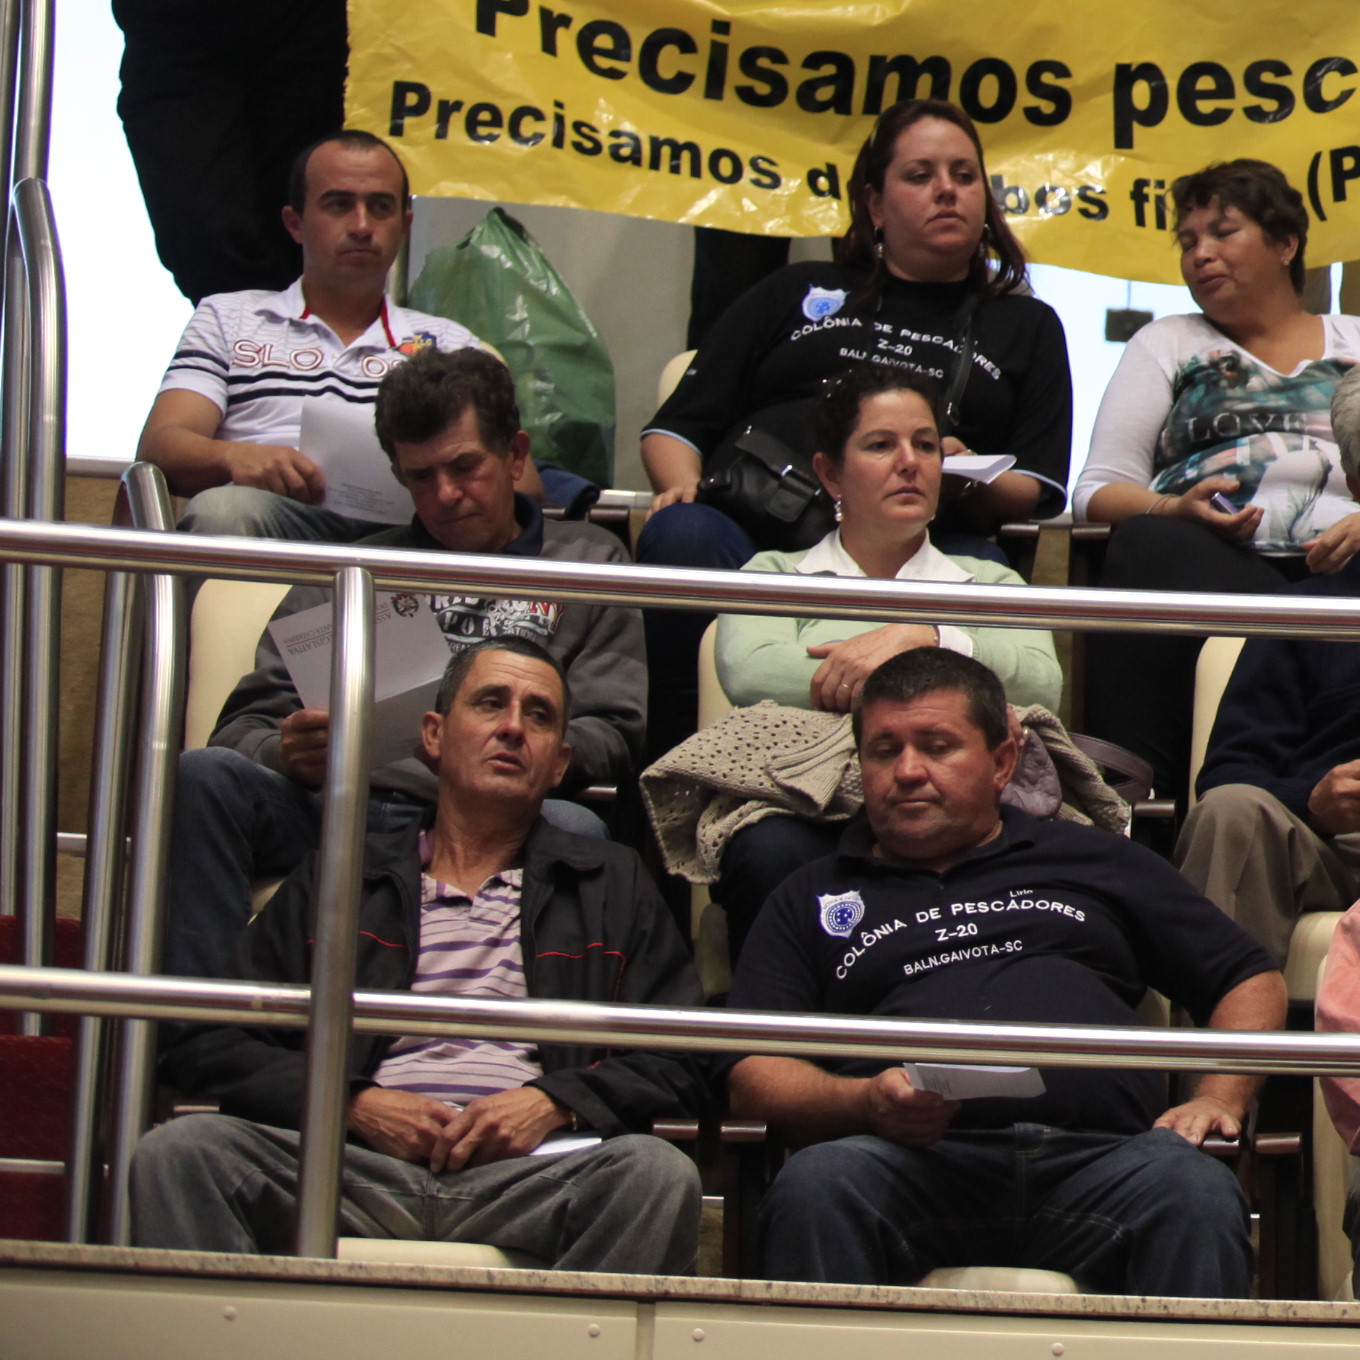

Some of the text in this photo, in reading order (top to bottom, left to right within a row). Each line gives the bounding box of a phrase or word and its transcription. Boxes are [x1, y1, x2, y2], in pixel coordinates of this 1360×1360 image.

[389, 80, 782, 190] Precisamos
[790, 315, 863, 342] COLÔNIA
[877, 338, 913, 357] Z-20
[1185, 411, 1308, 441] LOVE
[835, 899, 1086, 980] COLÔNIA DE PESCADORES
[935, 922, 979, 942] Z-20
[903, 940, 1024, 976] BALN.GAIVOTA-SC
